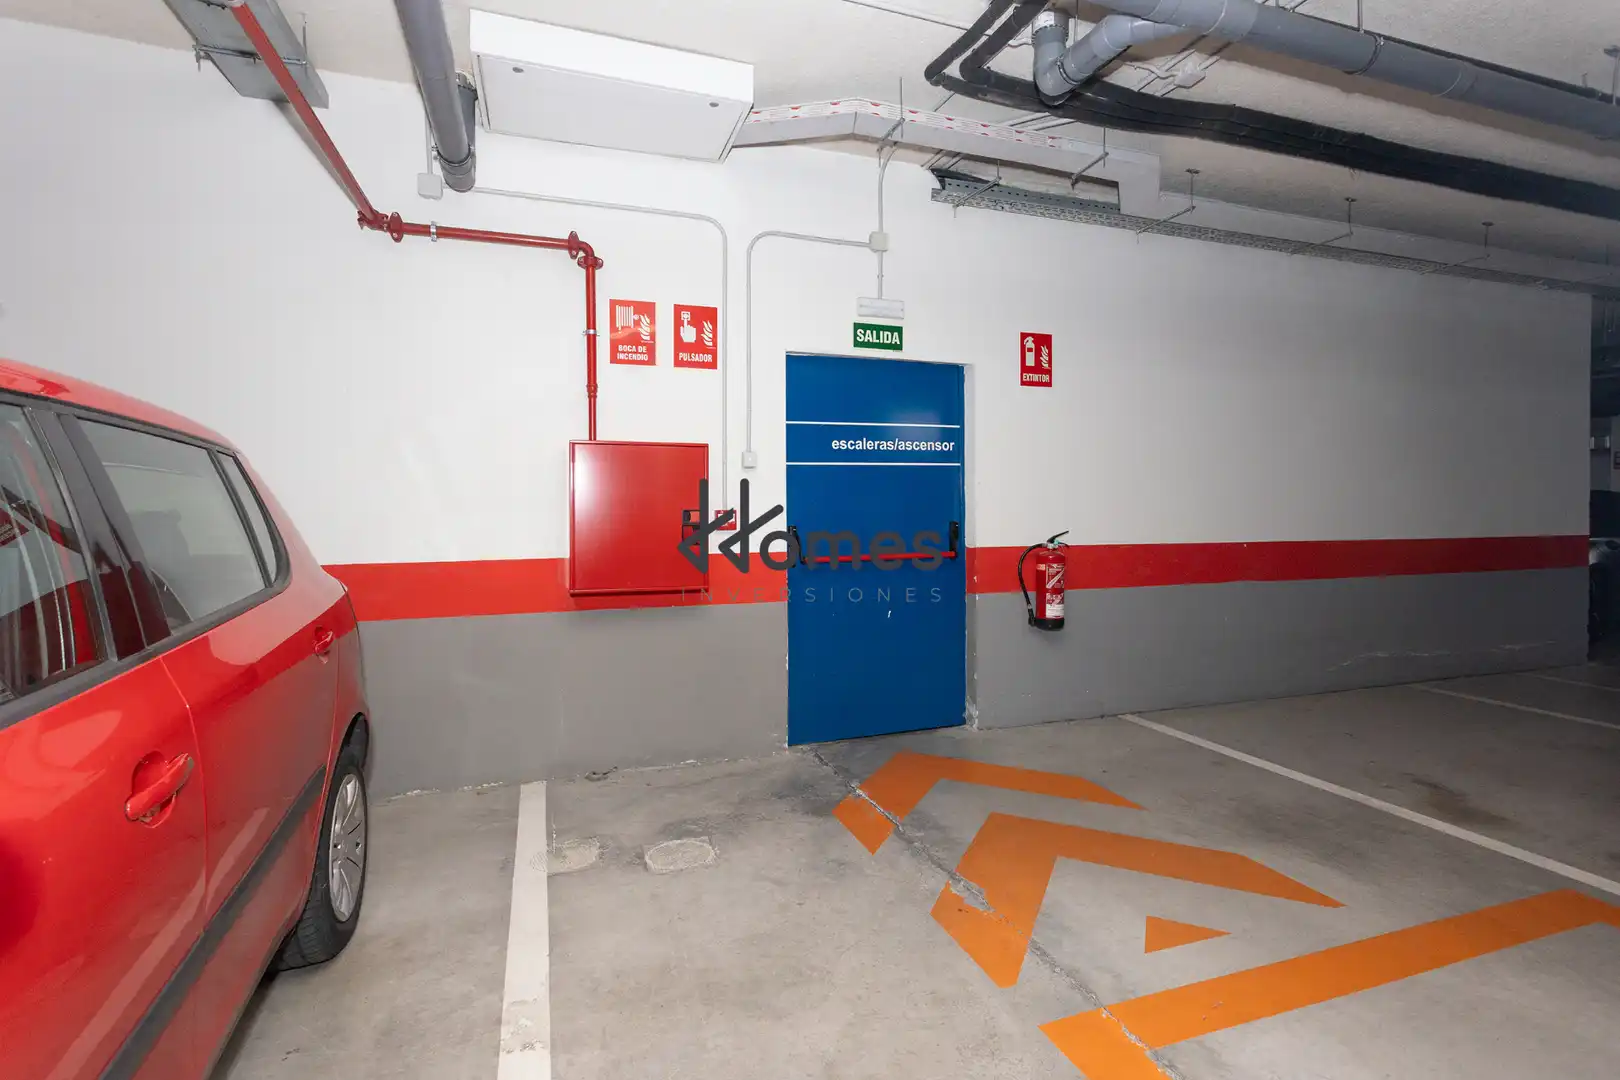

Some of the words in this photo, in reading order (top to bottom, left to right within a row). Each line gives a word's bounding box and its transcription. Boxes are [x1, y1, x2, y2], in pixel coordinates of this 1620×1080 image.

[856, 328, 900, 345] SALIDA
[618, 344, 636, 352] BOCA
[617, 353, 648, 361] INCENDIO
[679, 352, 713, 362] PULSADOR
[1022, 373, 1050, 382] EXTINTOR
[832, 437, 954, 451] escaleras/ascensor
